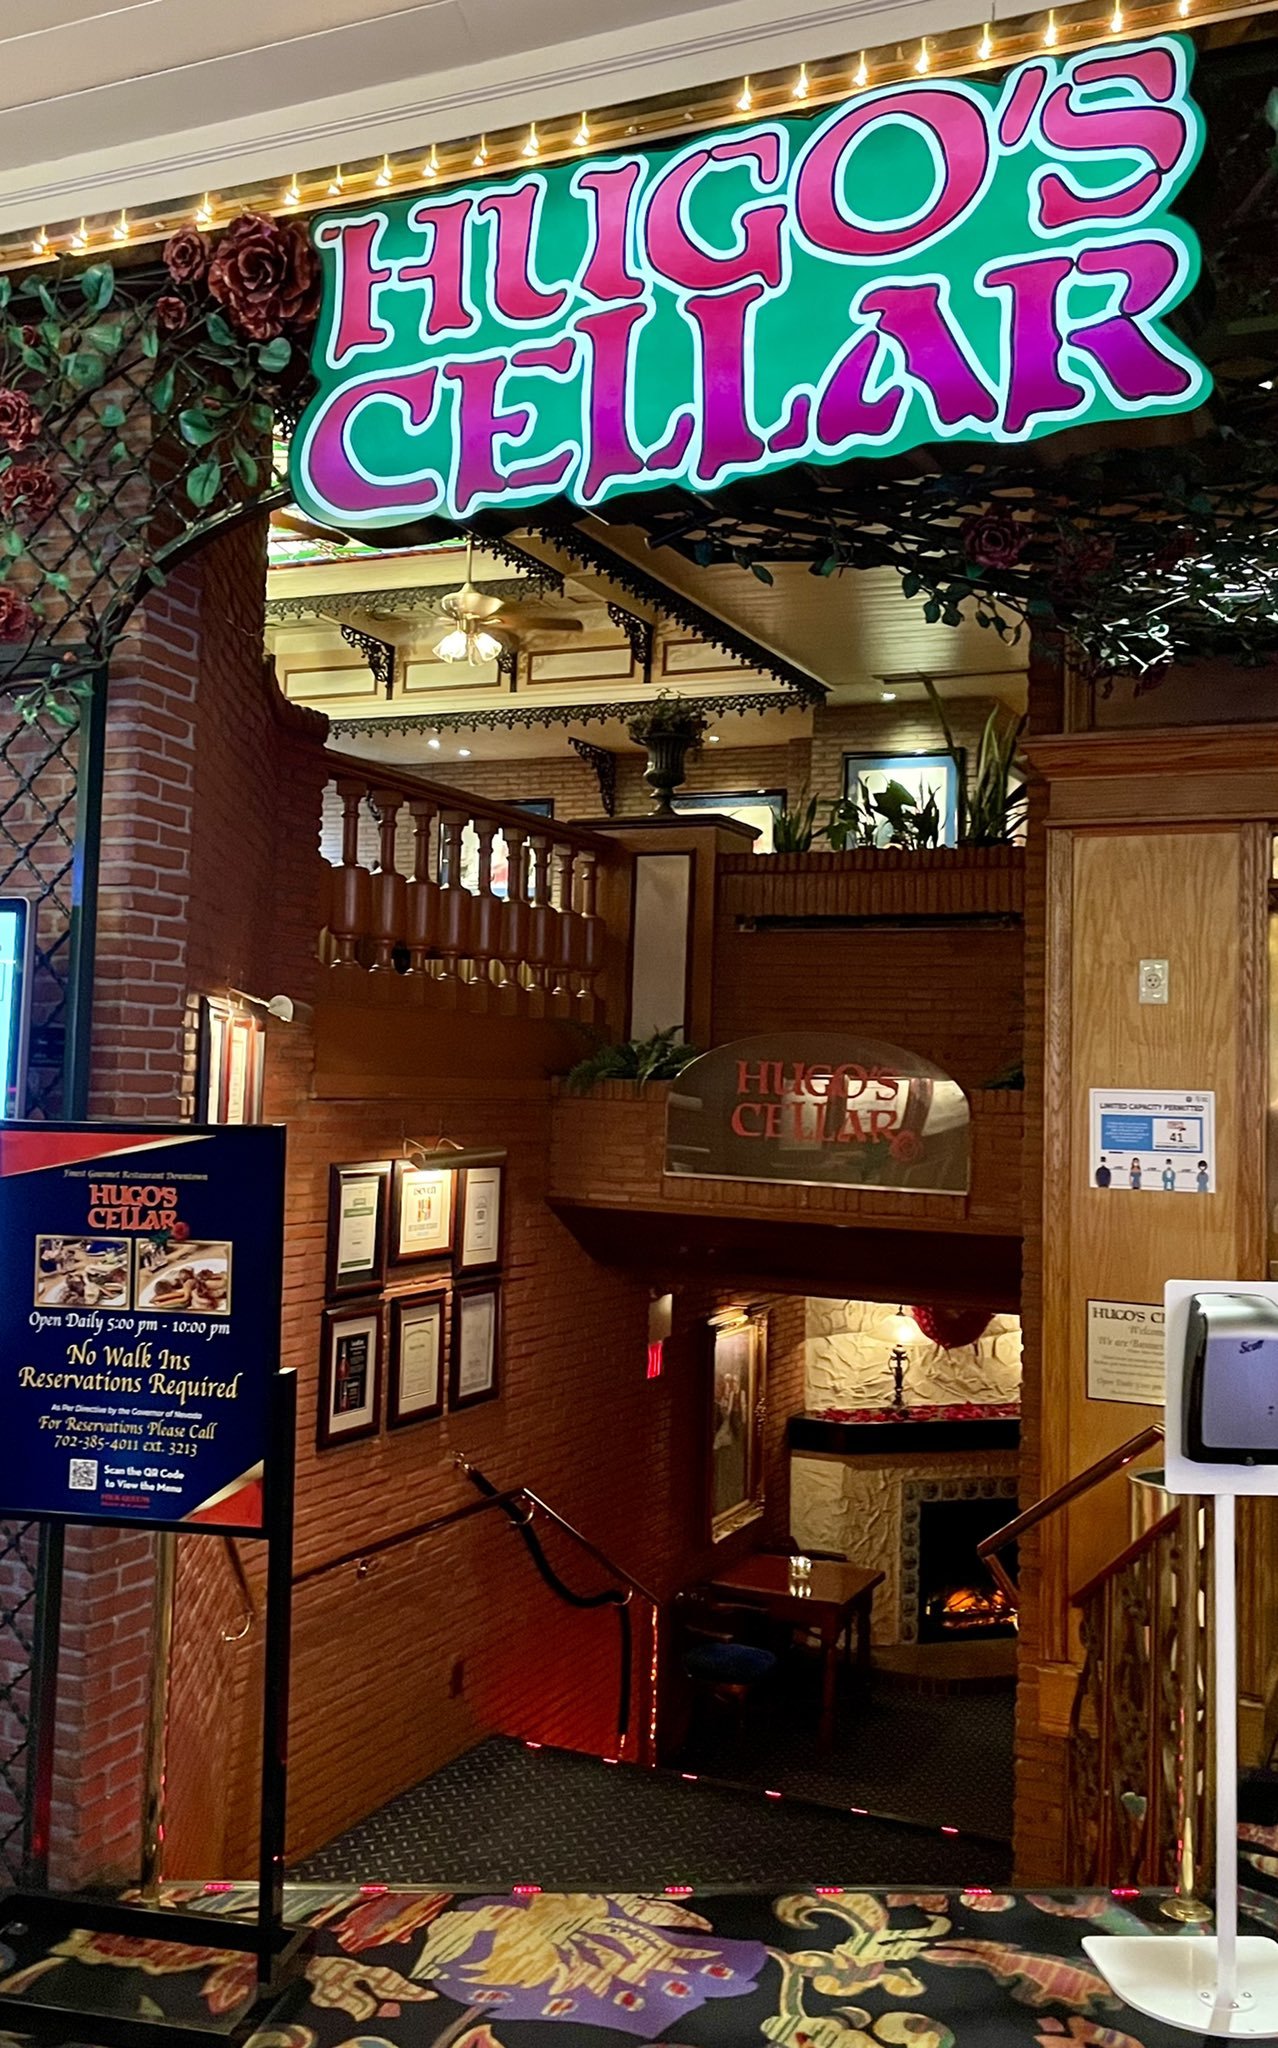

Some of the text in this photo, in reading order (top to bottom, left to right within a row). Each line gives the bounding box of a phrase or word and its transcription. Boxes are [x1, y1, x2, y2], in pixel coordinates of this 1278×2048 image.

[319, 40, 1192, 364] HUGO'S
[305, 234, 1195, 516] CELLAR
[736, 1060, 899, 1100] HUGO'S
[1129, 1103, 1161, 1111] CAPACITY
[731, 1101, 900, 1144] CELLAR
[1170, 1133, 1184, 1143] 41
[89, 1184, 178, 1207] HUGO'S
[87, 1207, 177, 1230] CELLAR
[28, 1311, 62, 1333] Open
[65, 1311, 103, 1335] Daily
[107, 1318, 134, 1331] 5:00
[134, 1320, 158, 1337] pm
[172, 1321, 206, 1334] 10:00
[206, 1323, 230, 1341] pm
[1093, 1307, 1145, 1323] HUGO'S
[67, 1339, 191, 1371] No Walk Ins
[18, 1366, 243, 1406] Reservations Required
[107, 1406, 117, 1416] by
[38, 1415, 218, 1440] For Reservations Please Call
[54, 1435, 198, 1457] 702-385-4011 ext. 3213
[104, 1465, 185, 1479] Scan the QR Code
[105, 1479, 182, 1493] to View the Menu
